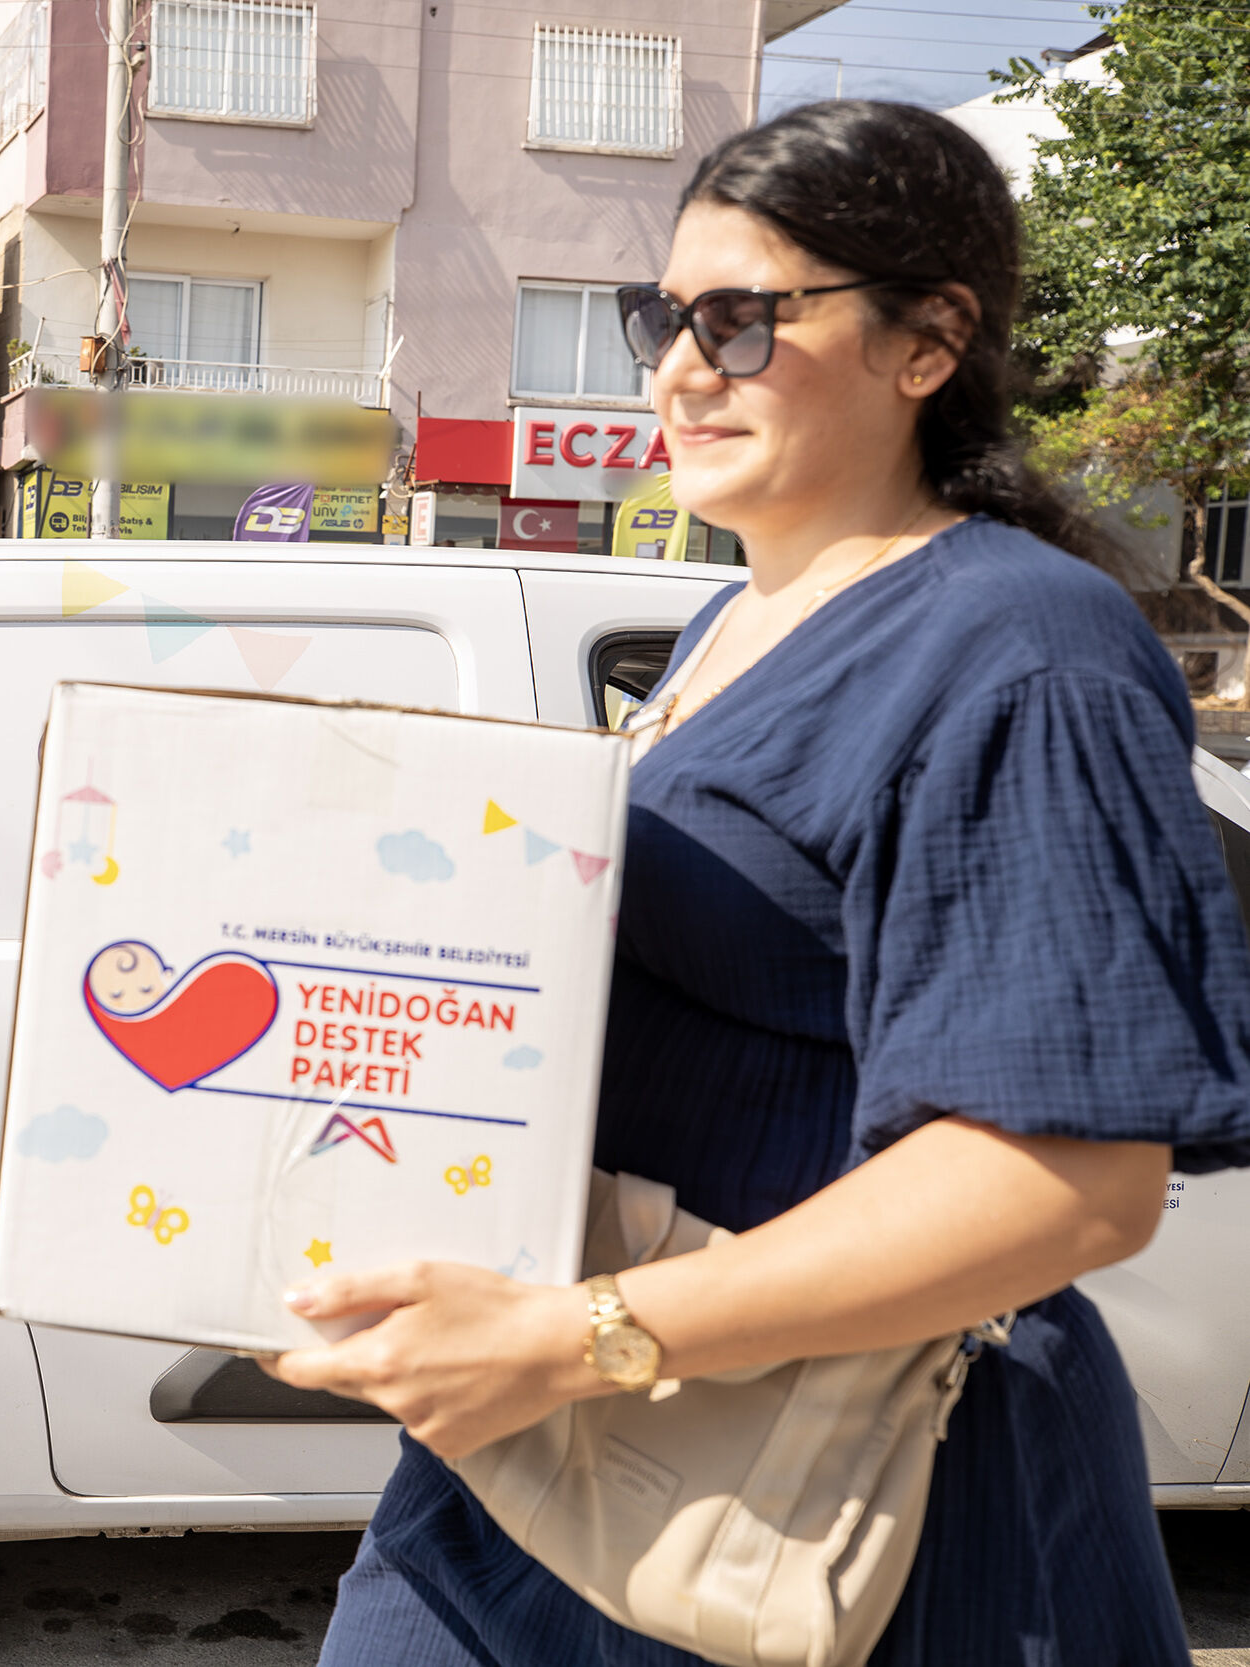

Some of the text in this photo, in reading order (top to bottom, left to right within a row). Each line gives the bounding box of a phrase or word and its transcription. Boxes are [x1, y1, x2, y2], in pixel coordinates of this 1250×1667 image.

[524, 420, 671, 470] ECZA
[298, 981, 515, 1032] YENİDOĞAN
[295, 1020, 423, 1060] DESTEK
[290, 1056, 411, 1096] PAKETİ
